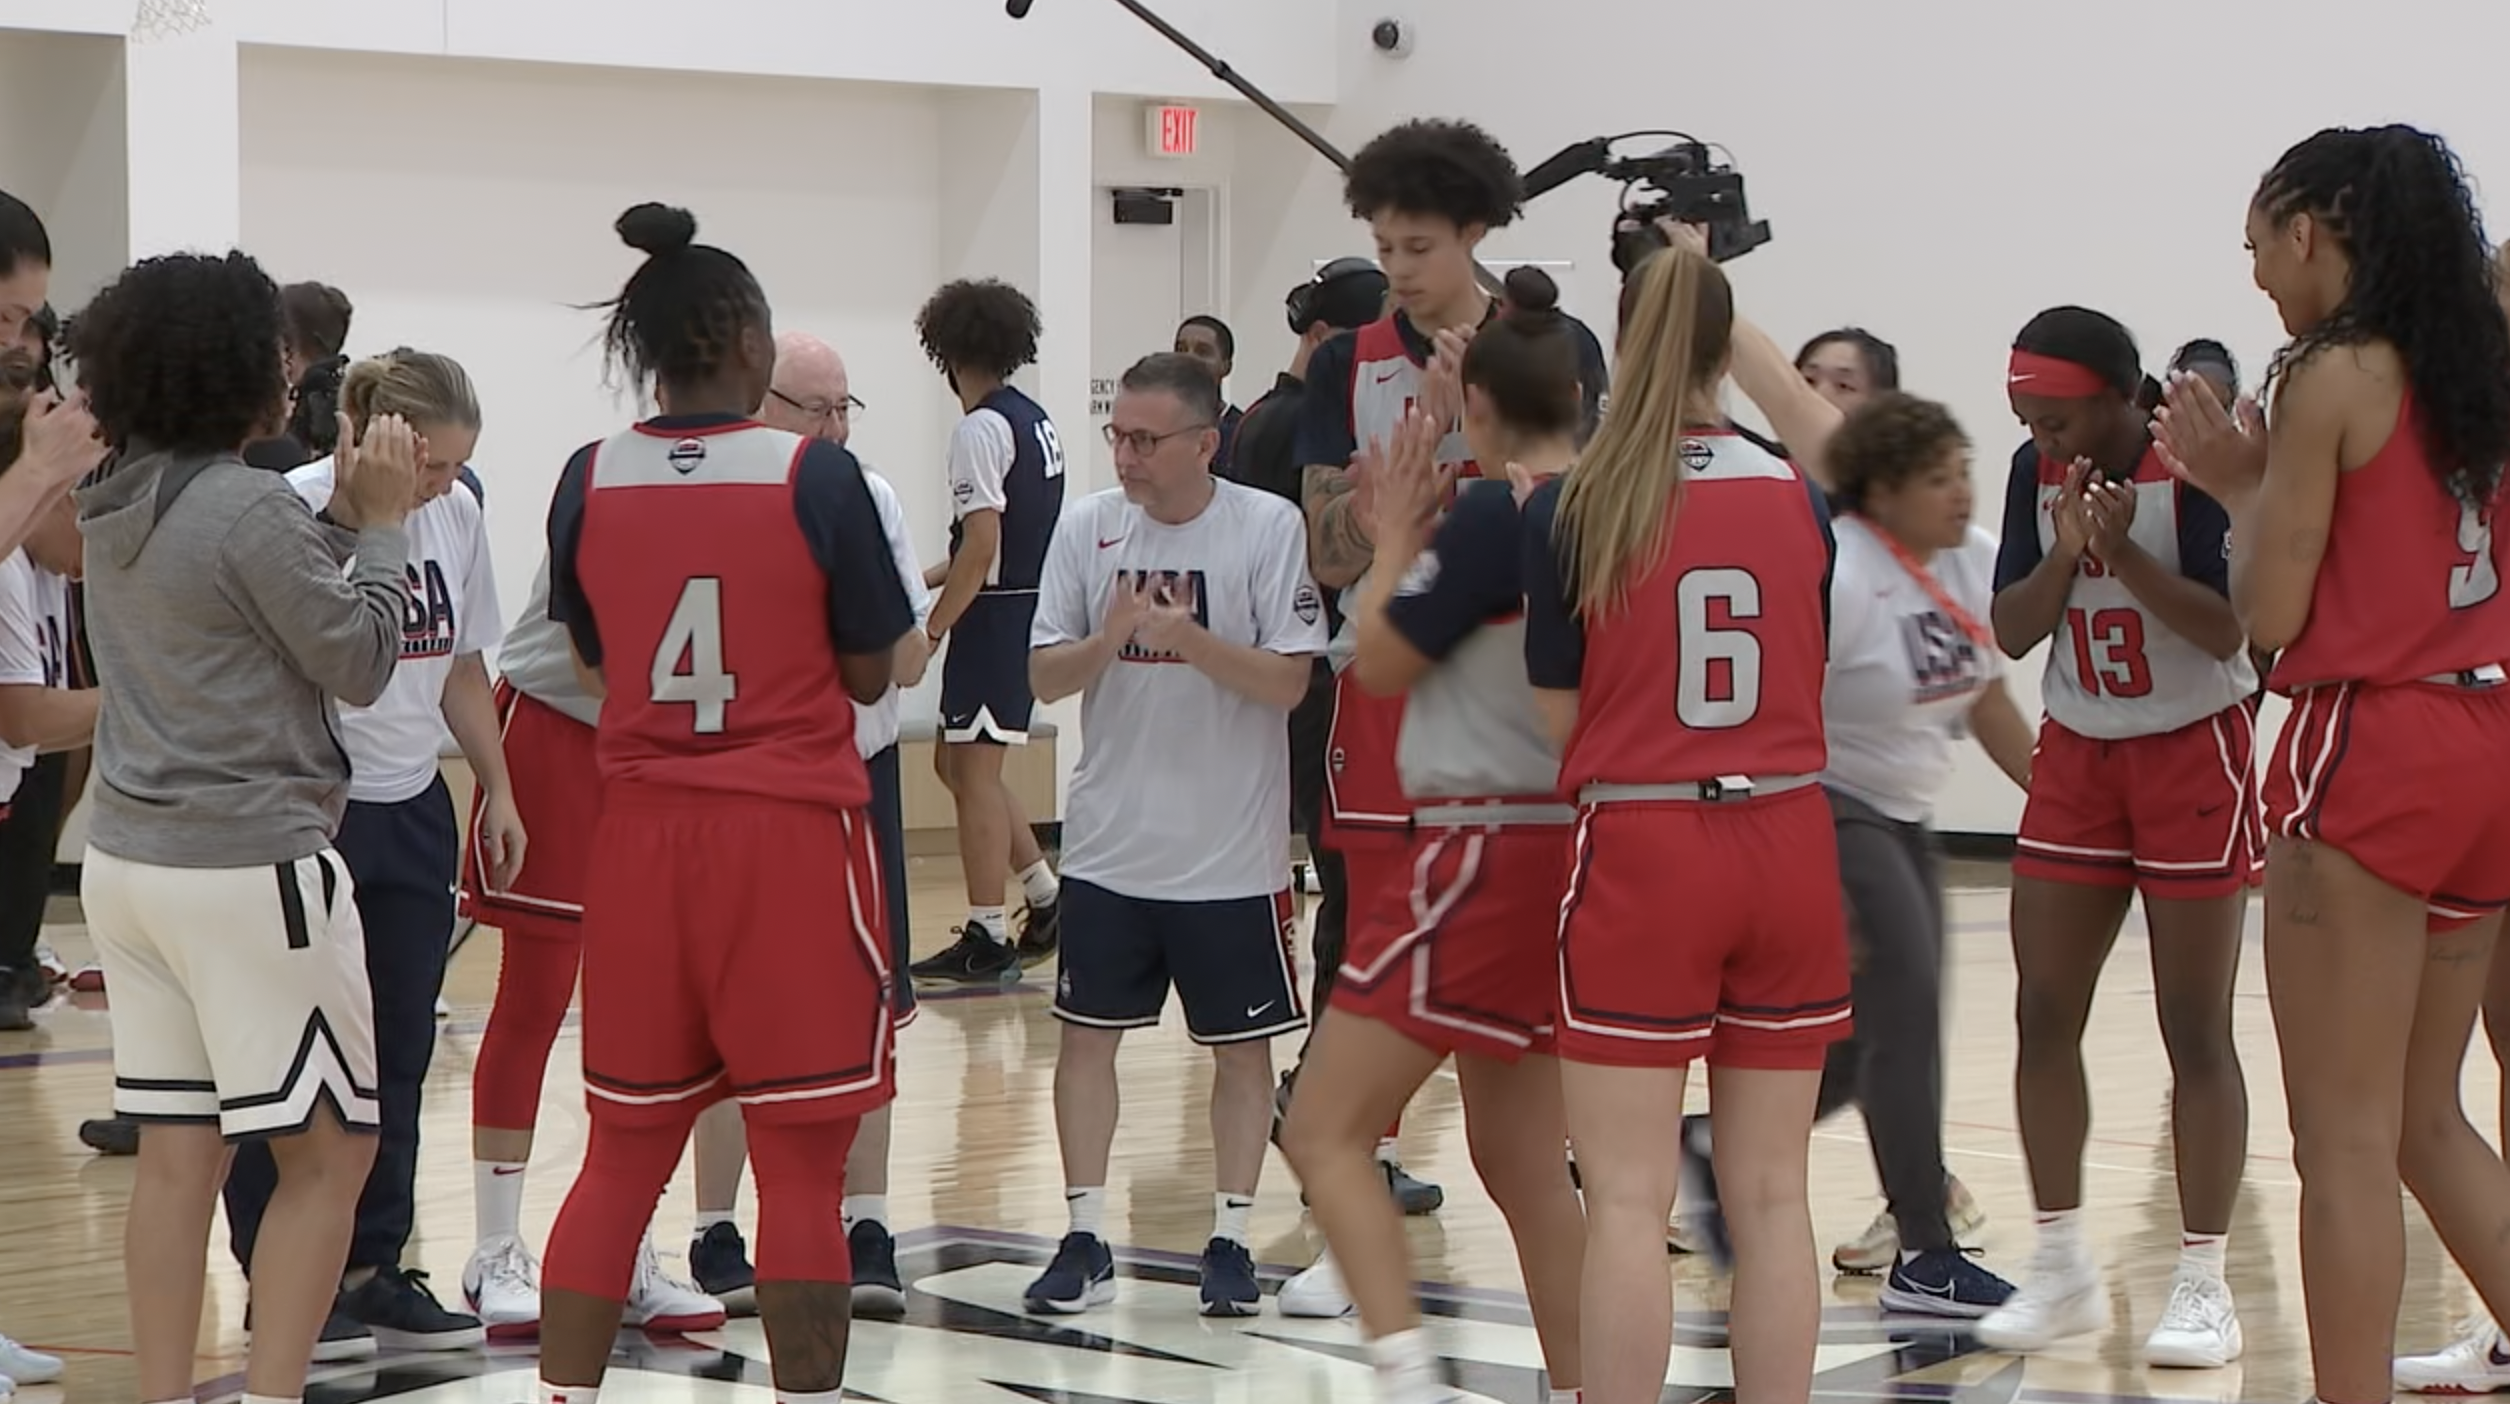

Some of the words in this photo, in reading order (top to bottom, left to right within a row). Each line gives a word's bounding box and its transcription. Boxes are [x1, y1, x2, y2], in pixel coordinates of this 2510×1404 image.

[1163, 109, 1197, 153] EXIT
[1034, 419, 1063, 479] 18
[402, 559, 456, 639] SA
[649, 575, 738, 733] 4
[1675, 566, 1763, 730] 6
[2067, 607, 2153, 698] 13
